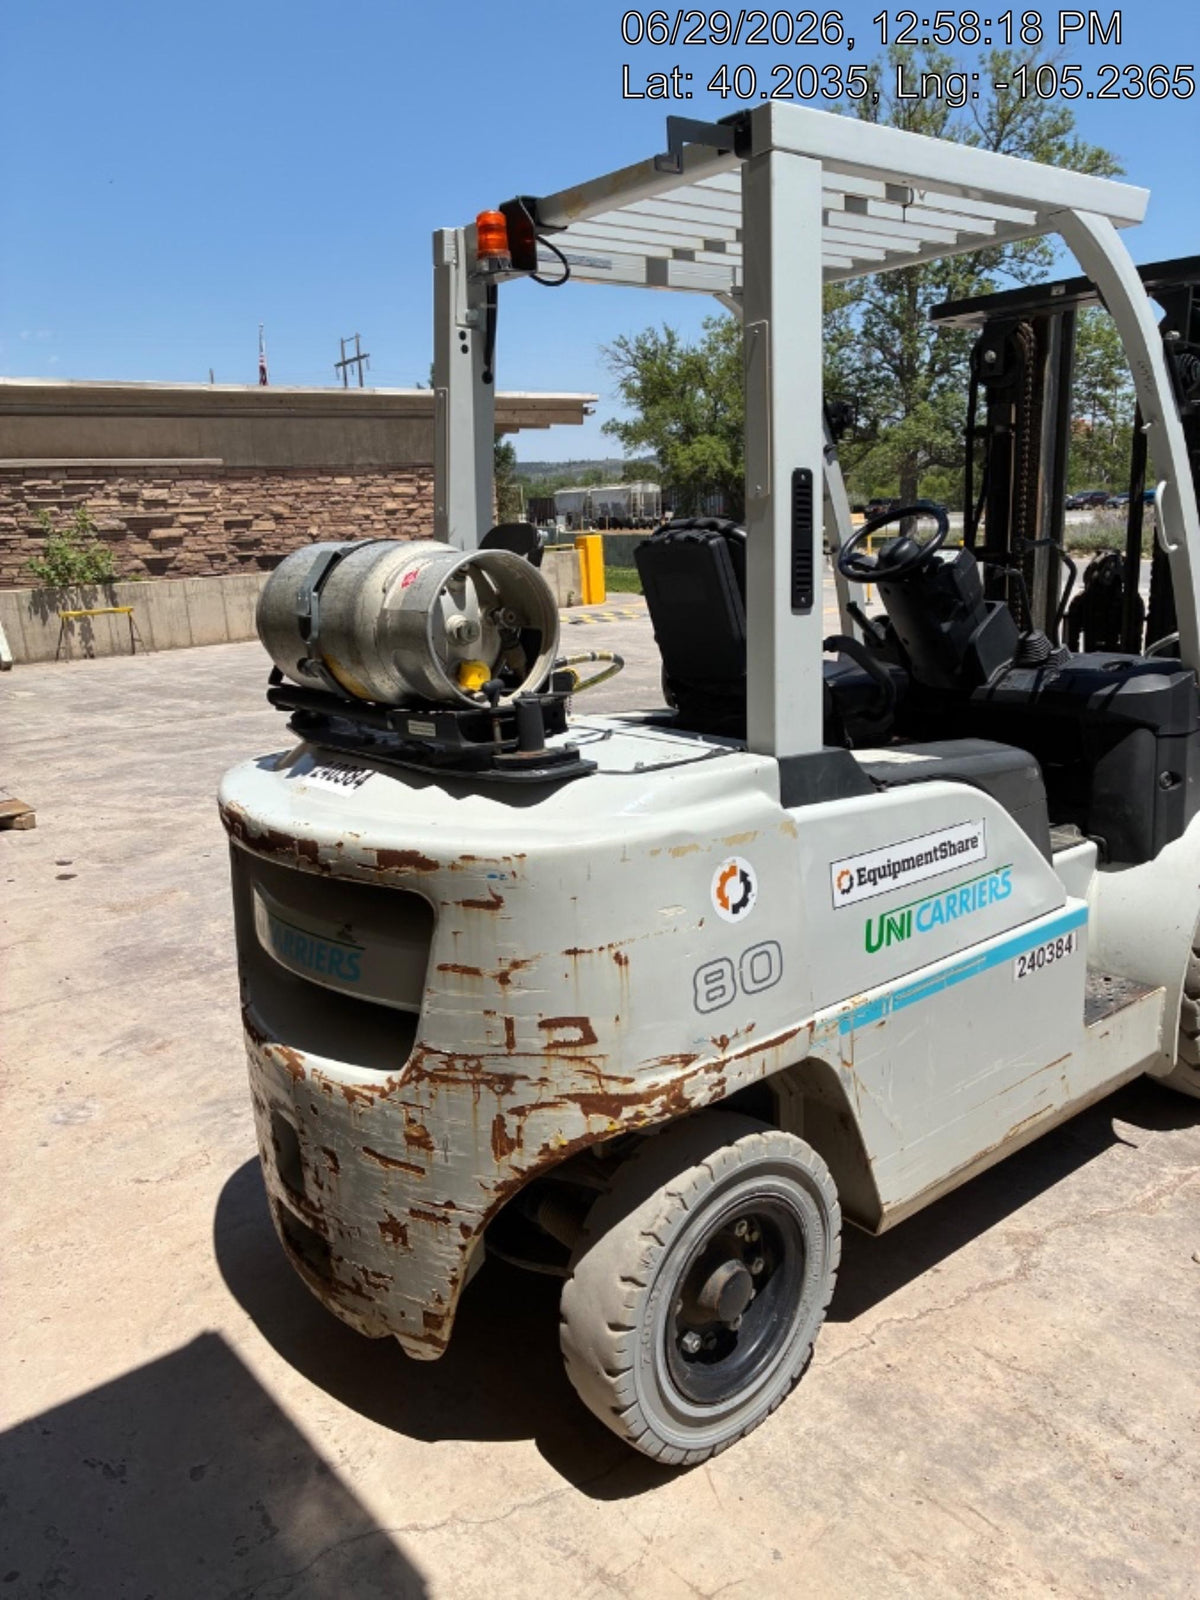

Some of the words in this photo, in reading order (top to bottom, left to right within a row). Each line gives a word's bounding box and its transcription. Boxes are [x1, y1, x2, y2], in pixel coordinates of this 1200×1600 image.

[856, 835, 979, 886] EquipmentShare
[692, 939, 784, 1015] 80
[1017, 933, 1073, 979] 240384
